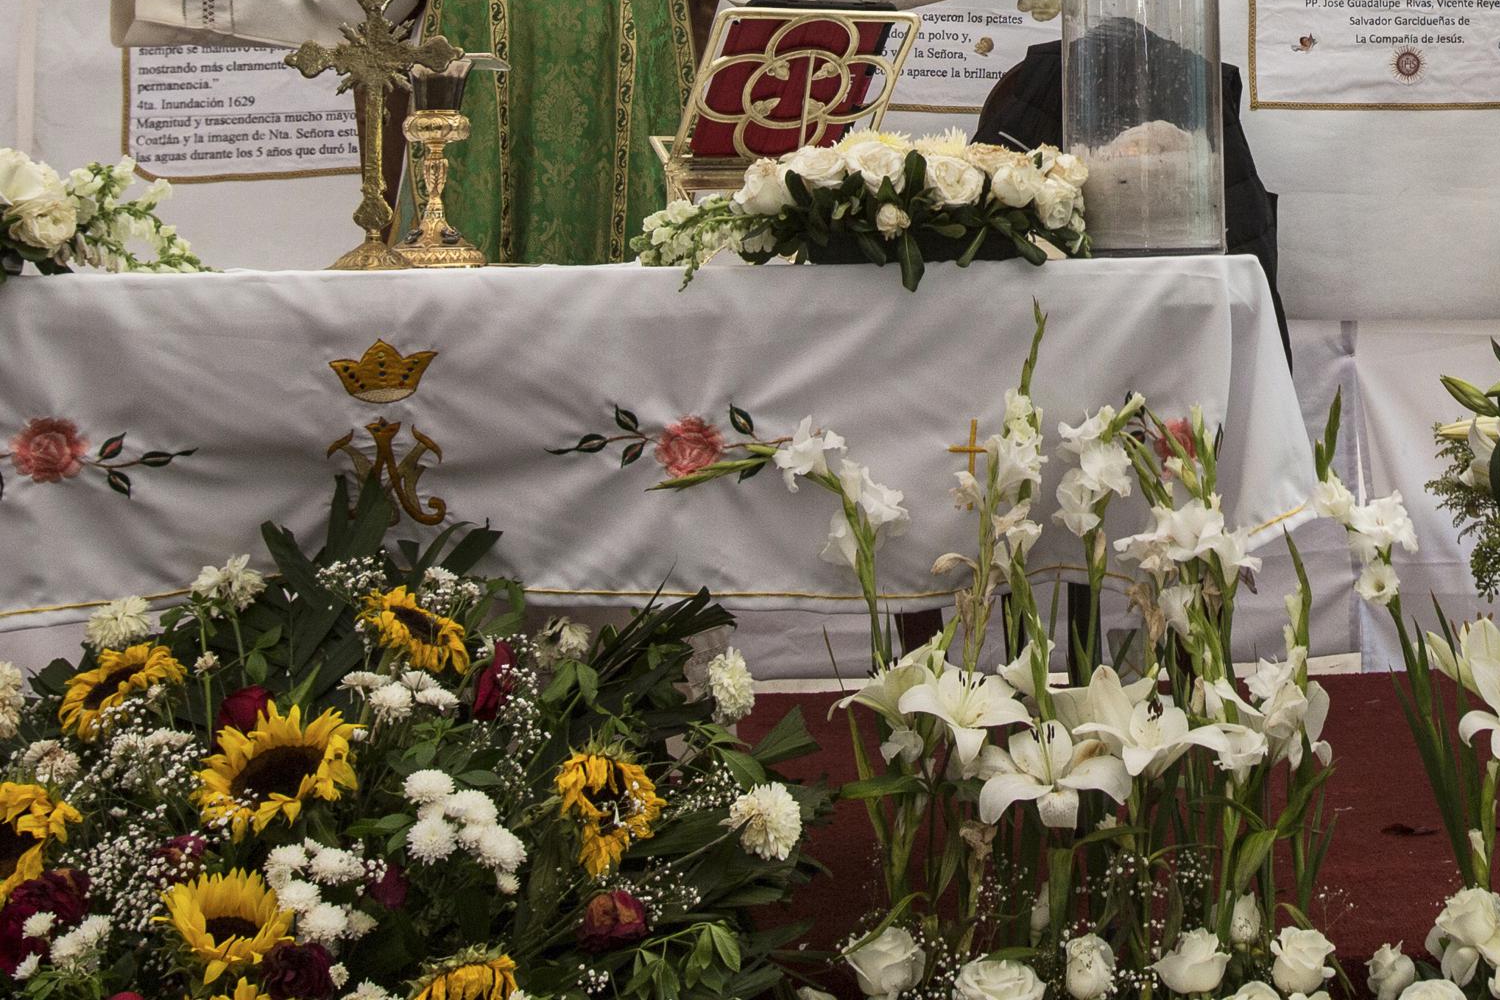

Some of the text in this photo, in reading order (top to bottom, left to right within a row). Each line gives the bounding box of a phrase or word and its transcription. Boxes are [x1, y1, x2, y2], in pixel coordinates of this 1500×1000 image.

[1305, 0, 1320, 8] PP.
[922, 12, 1023, 26] cayeron los petates
[1349, 16, 1470, 26] Salvador Garcidueñas de
[928, 30, 959, 42] polvo
[961, 32, 972, 44] y,
[1356, 33, 1465, 45] La Compañía de Jesús.
[914, 48, 967, 61] la Señora,
[139, 62, 197, 75] mostrando
[200, 62, 223, 73] más
[226, 60, 287, 72] claramente
[907, 68, 948, 79] aparece
[951, 67, 960, 78] la
[162, 97, 224, 109] Inundación
[228, 96, 256, 107] 1629
[137, 117, 191, 130] Magnitud
[194, 119, 201, 128] y
[205, 114, 281, 126] trascendencia
[284, 112, 323, 122] mucho
[183, 136, 190, 146] y
[194, 133, 204, 143] la
[208, 132, 249, 144] imagen
[252, 130, 265, 141] de
[269, 129, 292, 139] Nta.
[296, 128, 334, 139] Señora
[136, 143, 358, 164] las aguas durante los 5 años que duró la
